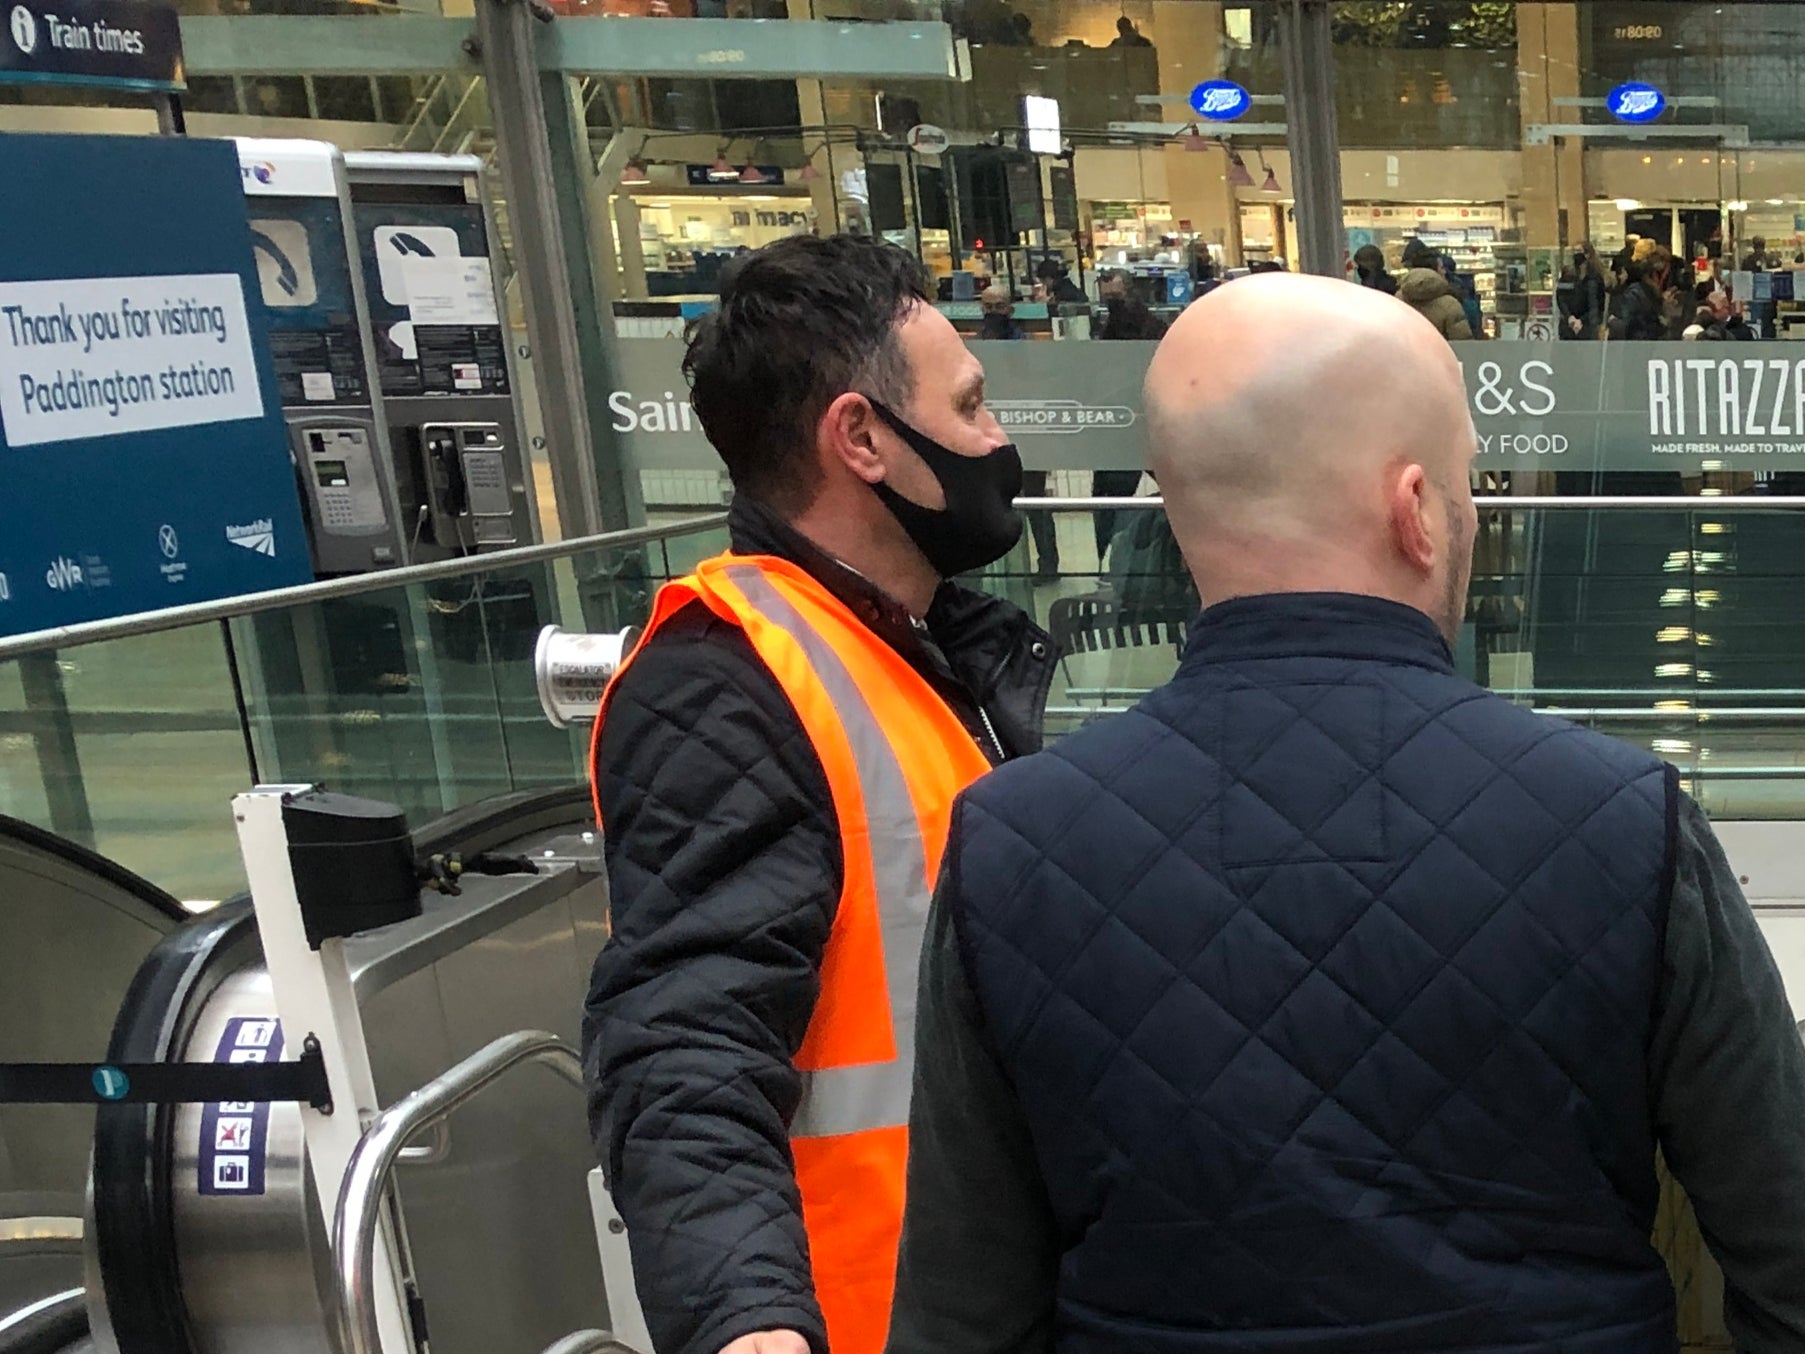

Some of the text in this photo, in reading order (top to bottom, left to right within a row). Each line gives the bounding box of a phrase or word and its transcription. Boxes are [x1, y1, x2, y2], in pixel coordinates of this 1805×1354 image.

[44, 14, 144, 54] Train times
[2, 298, 226, 353] Thank you for visiting
[20, 370, 156, 417] Paddington
[159, 361, 235, 400] station
[1459, 361, 1556, 416] &S
[1000, 410, 1116, 424] BISHOP & BEAR
[1500, 434, 1568, 454] FOOD
[1652, 443, 1684, 453] MADE
[1724, 443, 1756, 453] MADE
[1757, 443, 1773, 453] TO
[47, 555, 83, 591] GWR
